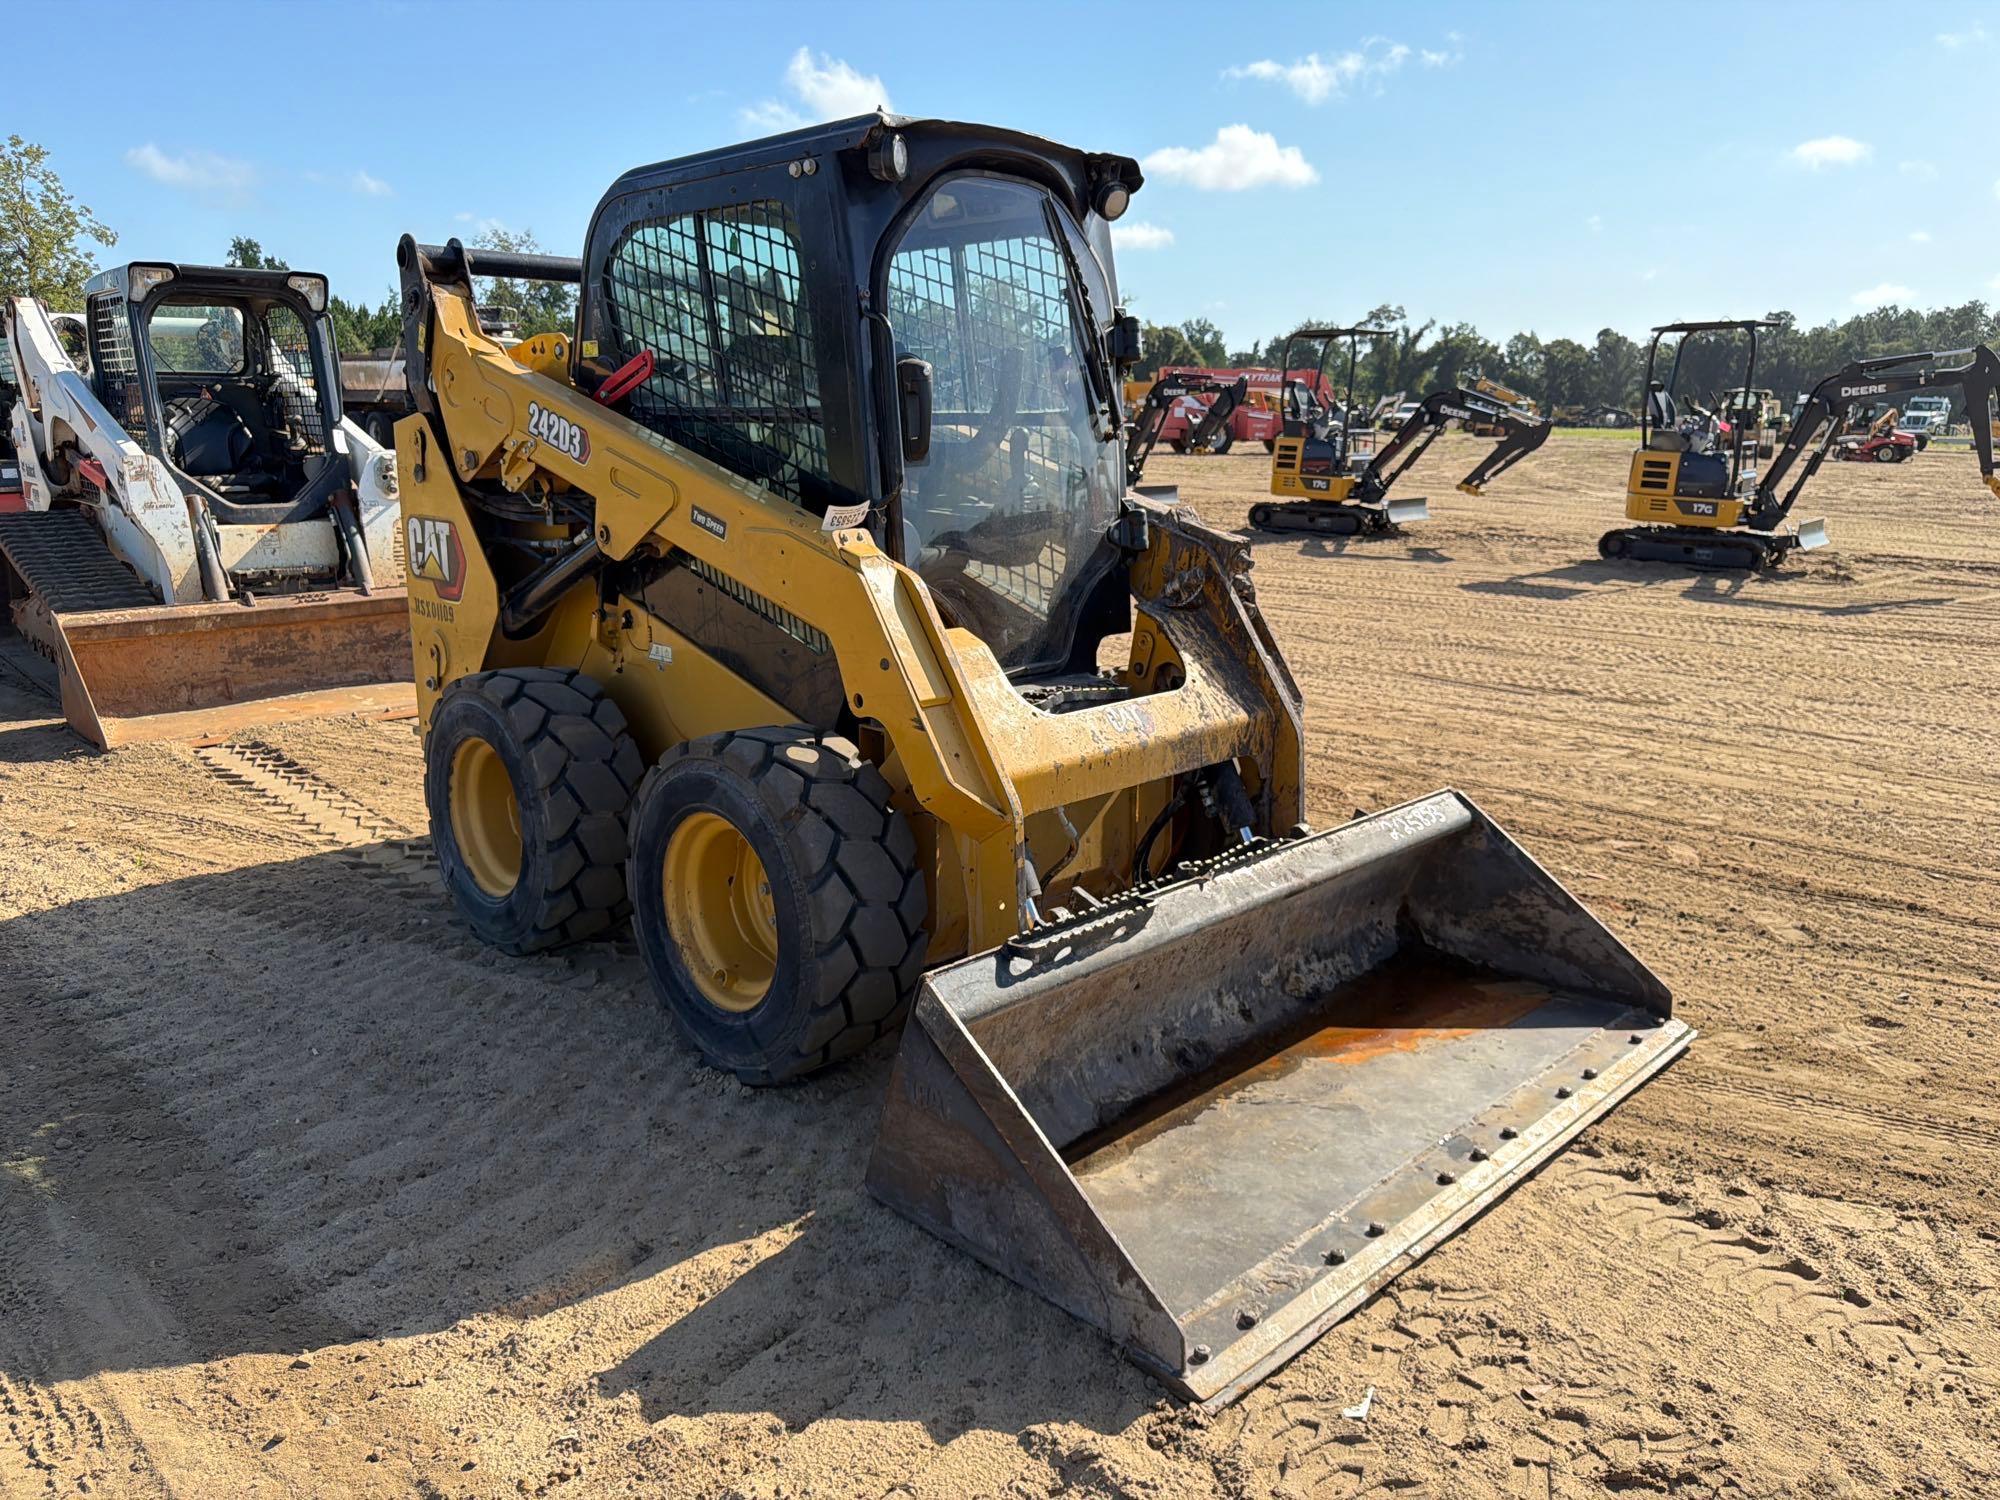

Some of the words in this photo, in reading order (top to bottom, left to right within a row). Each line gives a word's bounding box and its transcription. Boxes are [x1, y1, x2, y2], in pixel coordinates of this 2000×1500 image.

[1841, 384, 1887, 397] DEERE
[1440, 404, 1471, 419] DEERE
[528, 402, 581, 459] 242D3
[1312, 479, 1327, 489] 17G
[1693, 503, 1713, 514] 17G
[408, 517, 450, 582] CAT
